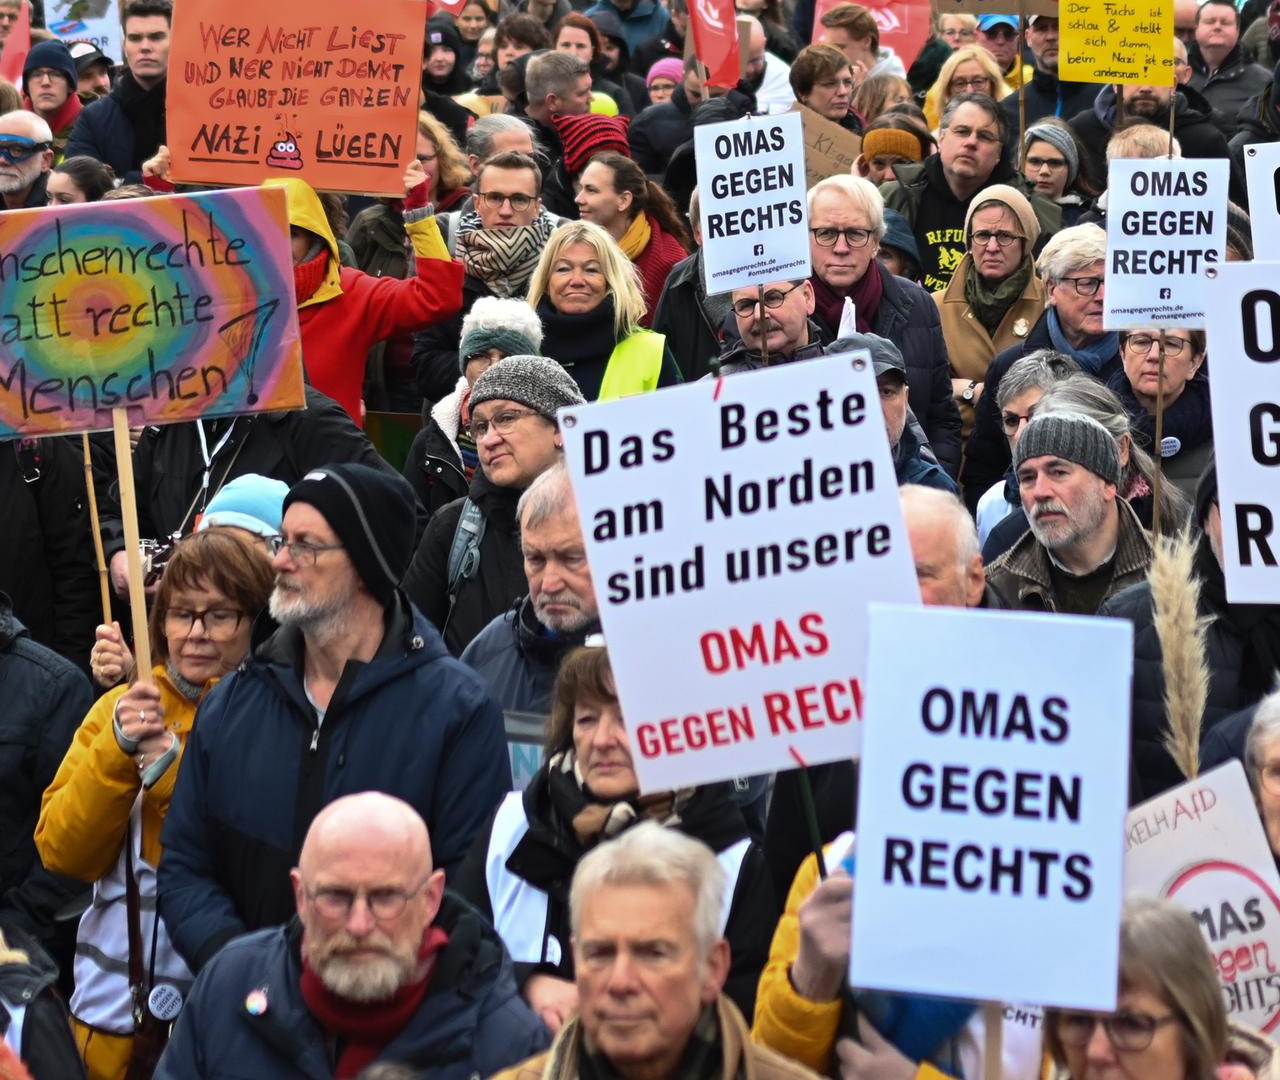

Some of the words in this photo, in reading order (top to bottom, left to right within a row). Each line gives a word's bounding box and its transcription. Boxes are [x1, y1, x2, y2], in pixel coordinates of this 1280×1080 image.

[1067, 3, 1090, 14] Der
[1103, 3, 1135, 16] Fuchs
[1150, 7, 1162, 17] ist
[1108, 19, 1120, 33] &
[200, 22, 250, 54] WER
[1085, 36, 1106, 47] sich
[185, 61, 220, 86] UND
[229, 57, 272, 80] WER
[336, 57, 404, 82] DENKT
[1068, 52, 1095, 64] beim
[1112, 52, 1135, 63] Nazi
[1145, 54, 1155, 65] ist
[1162, 58, 1173, 66] es
[209, 87, 276, 109] GLAUBT
[321, 86, 411, 108] GANZEN
[316, 123, 402, 159] LÜGEN
[715, 126, 785, 160] OMAS
[711, 163, 794, 200] GEGEN
[1131, 171, 1208, 197] OMAS
[707, 199, 803, 239] RECHTS
[1122, 210, 1214, 237] GEGEN
[712, 258, 776, 279] omasgegenrechts.de
[748, 259, 806, 278] #omasgegenrechts
[1112, 249, 1219, 276] RECHTS
[86, 282, 214, 337] rechte
[1110, 304, 1184, 315] omasgegenrechts.de
[1151, 310, 1205, 321] #omasgegenrec
[583, 428, 675, 477] Das
[720, 389, 867, 451] Beste
[593, 499, 663, 542] am
[705, 458, 874, 521] Norden
[607, 545, 705, 605] sind
[726, 522, 892, 584] unsere
[700, 613, 829, 675] OMAS
[921, 688, 1070, 744] OMAS
[636, 706, 755, 759] GEGEN
[902, 763, 1082, 823] GEGEN
[1126, 788, 1217, 849] KELHAfD
[884, 838, 1093, 902] RECHTS
[1192, 898, 1266, 942] MAS
[151, 986, 167, 1005] OMAS
[156, 991, 174, 1011] GEGEN
